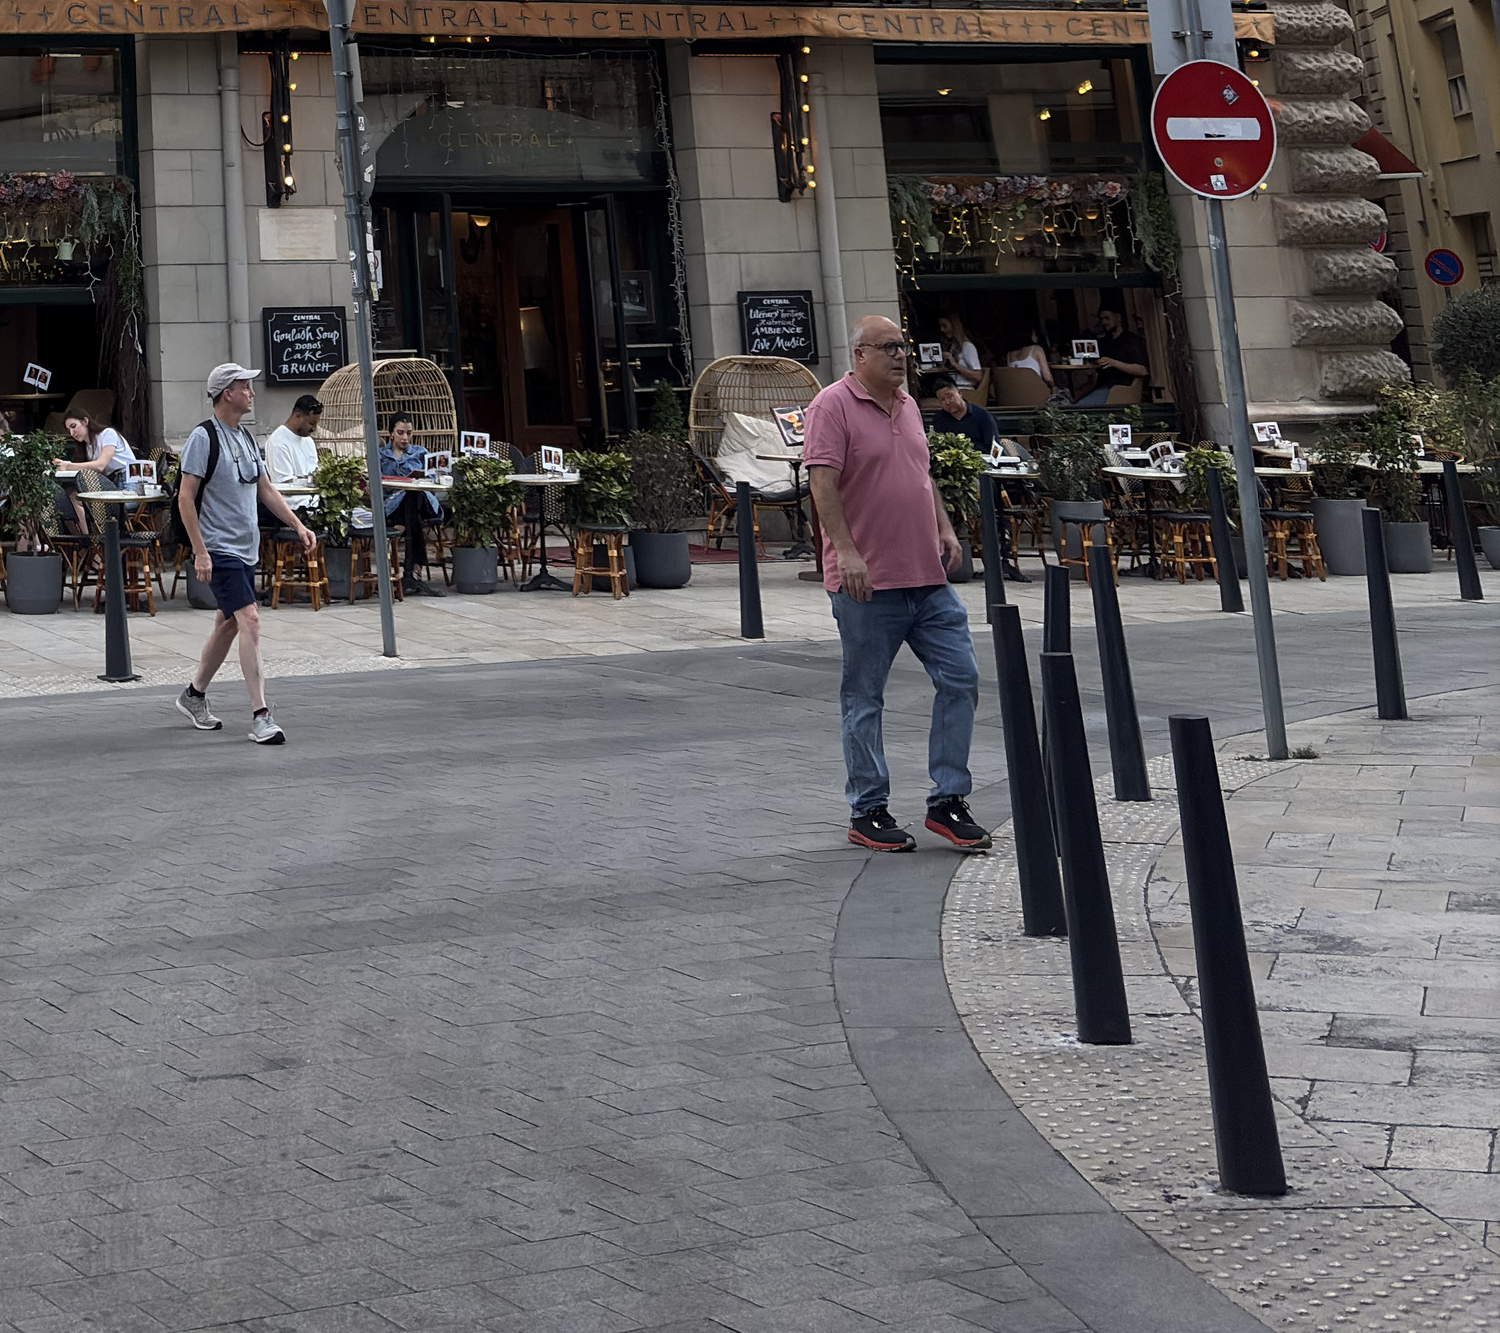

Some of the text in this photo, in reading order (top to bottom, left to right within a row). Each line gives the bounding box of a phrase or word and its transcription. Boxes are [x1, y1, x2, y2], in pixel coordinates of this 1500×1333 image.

[66, 3, 250, 27] CENTRAL
[356, 5, 508, 29] ENTRAL
[591, 10, 758, 32] CENTRAL
[837, 13, 991, 36] CENTRAL
[1066, 17, 1149, 38] CENT
[438, 132, 558, 147] CENTRAL
[11, 272, 37, 281] LIFE
[273, 326, 340, 345] Goulash Soup
[752, 326, 803, 335] AMBIENCE
[750, 336, 809, 352] Live Music
[283, 348, 329, 361] Cake
[280, 362, 332, 374] BRUNCH
